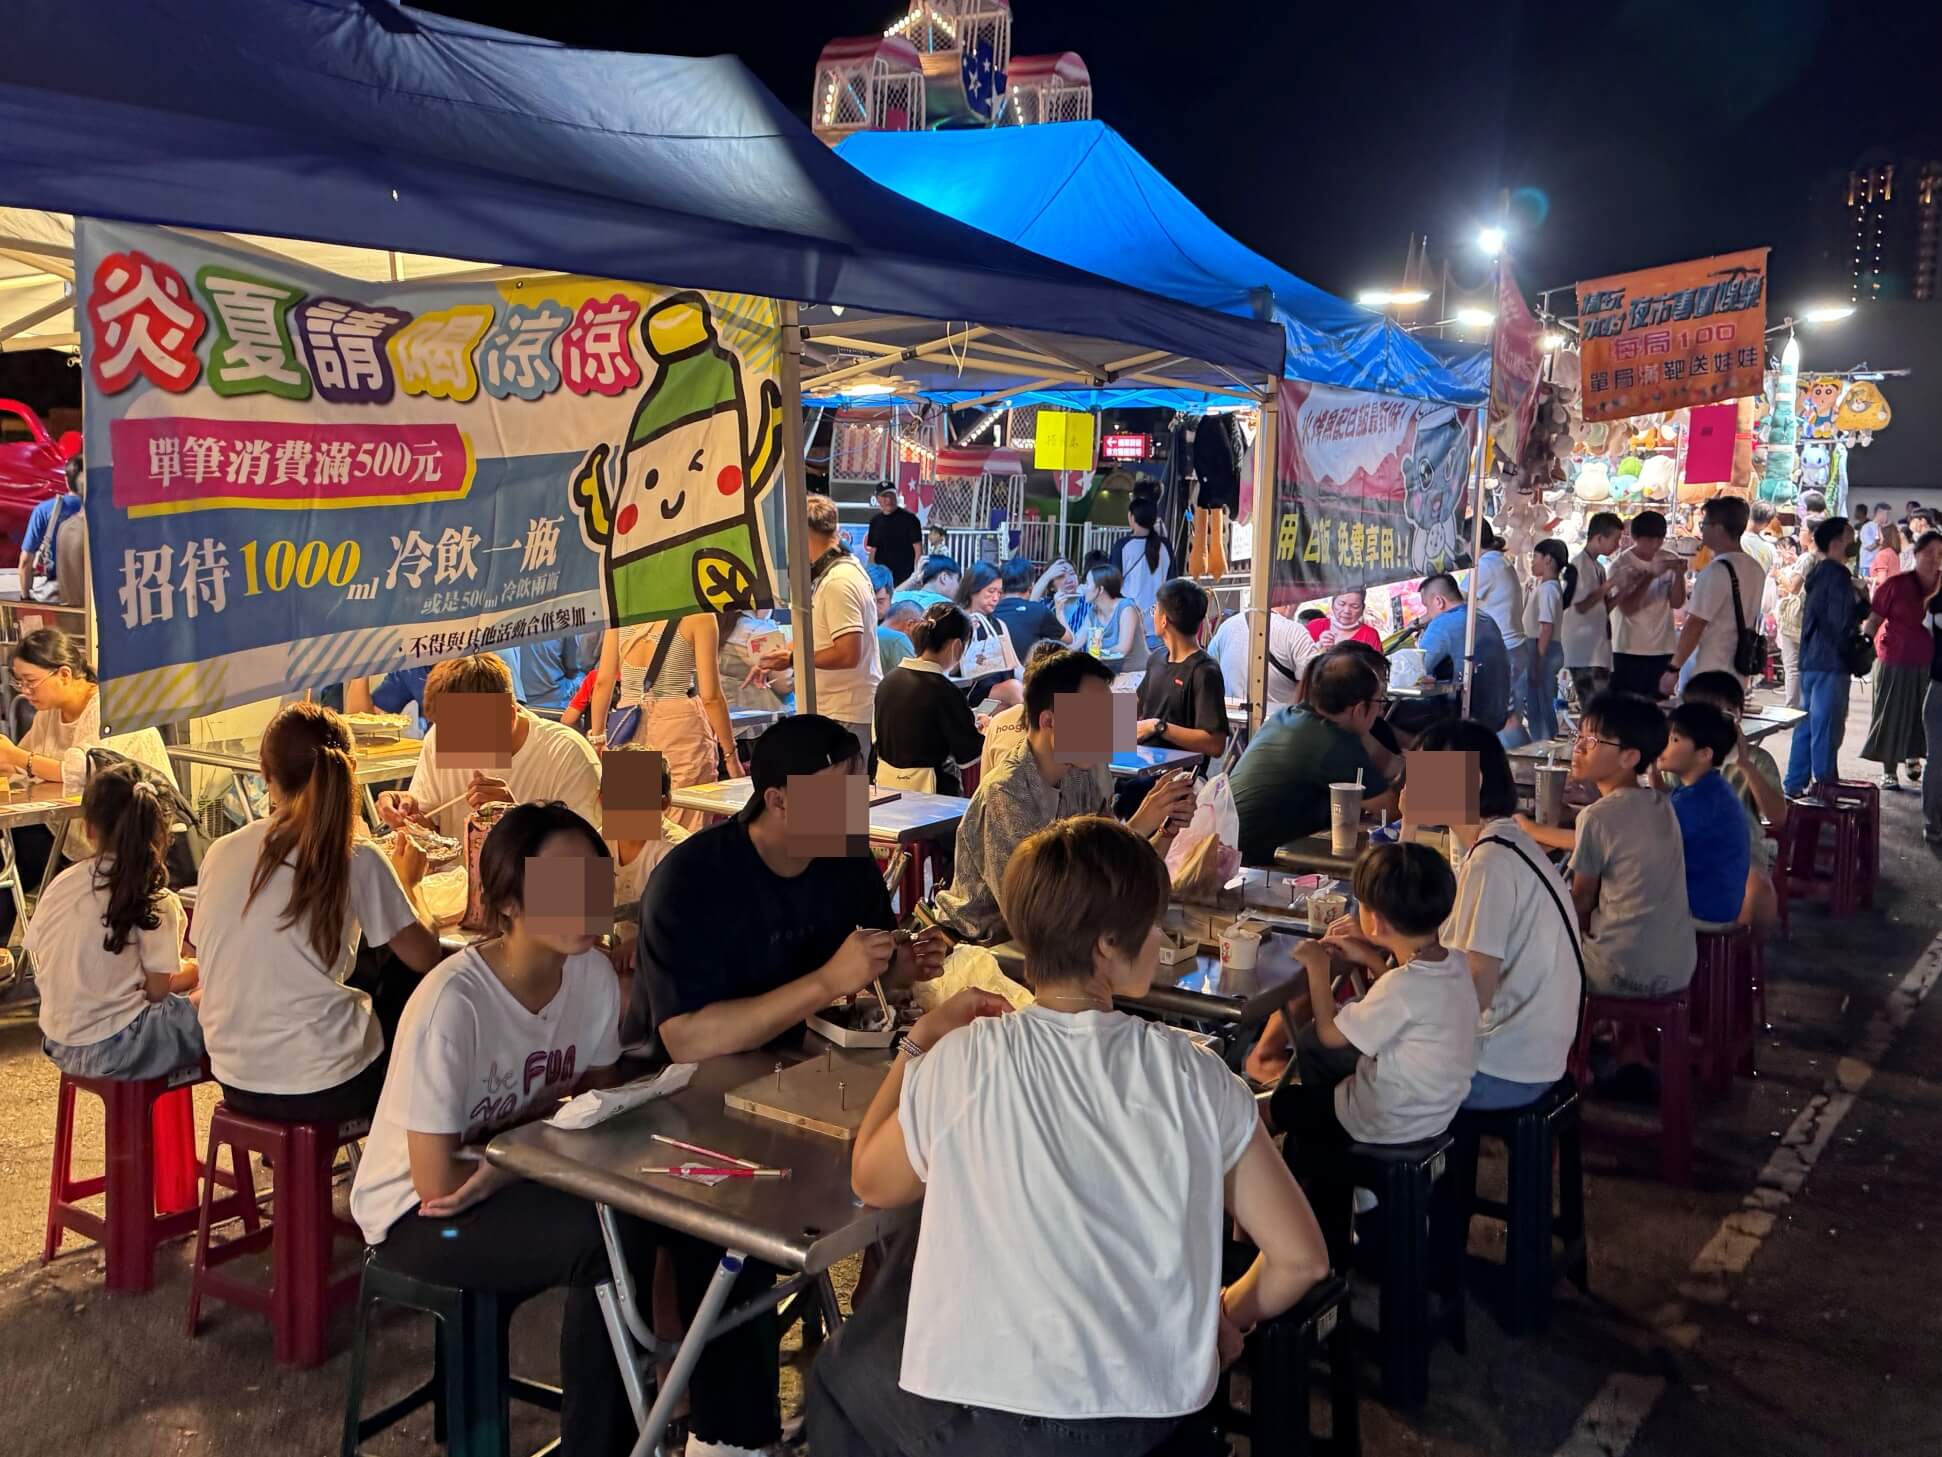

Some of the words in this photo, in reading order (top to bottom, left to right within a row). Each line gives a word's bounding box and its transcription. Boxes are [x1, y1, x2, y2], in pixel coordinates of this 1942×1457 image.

[1590, 347, 1759, 393] 單局滿靶送娃娃
[149, 437, 443, 487] 單筆消費滿500元
